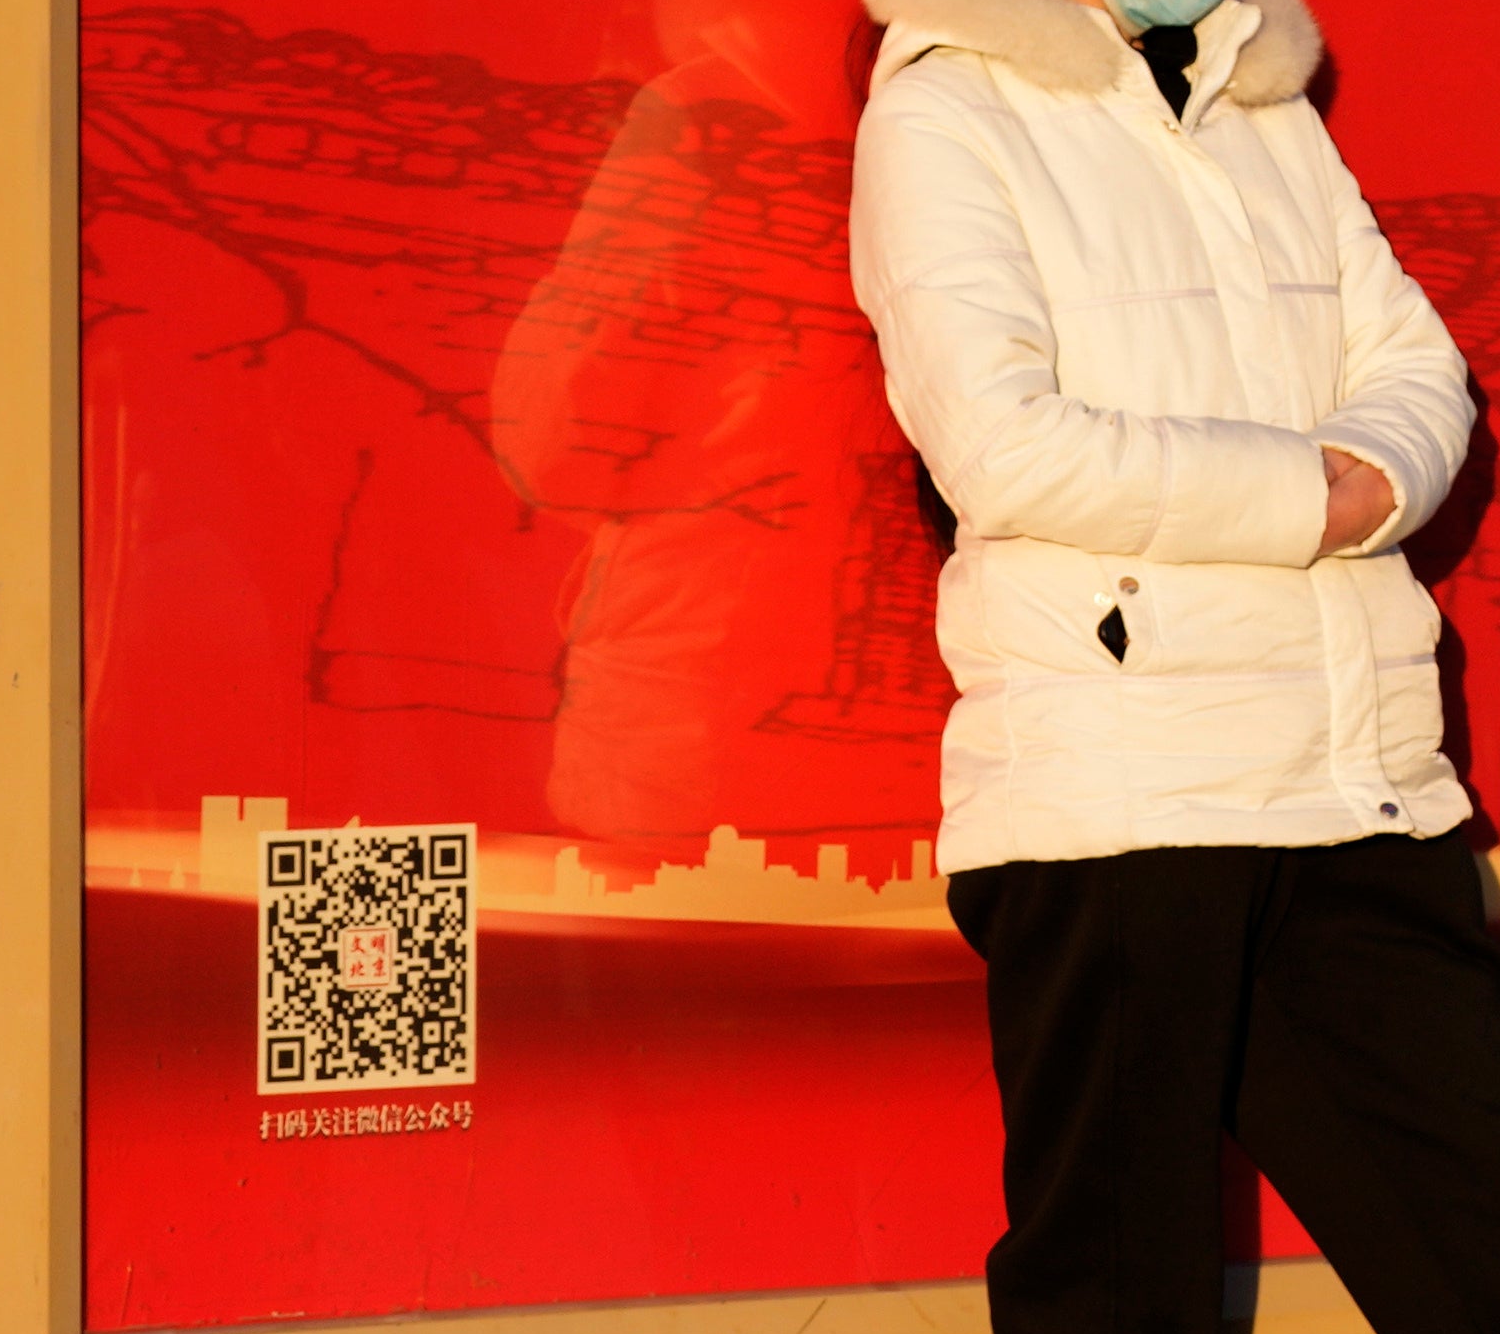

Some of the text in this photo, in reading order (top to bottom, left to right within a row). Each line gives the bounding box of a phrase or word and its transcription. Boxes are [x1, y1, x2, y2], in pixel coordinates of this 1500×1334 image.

[258, 1100, 475, 1141] 扫码关注微信公众号
